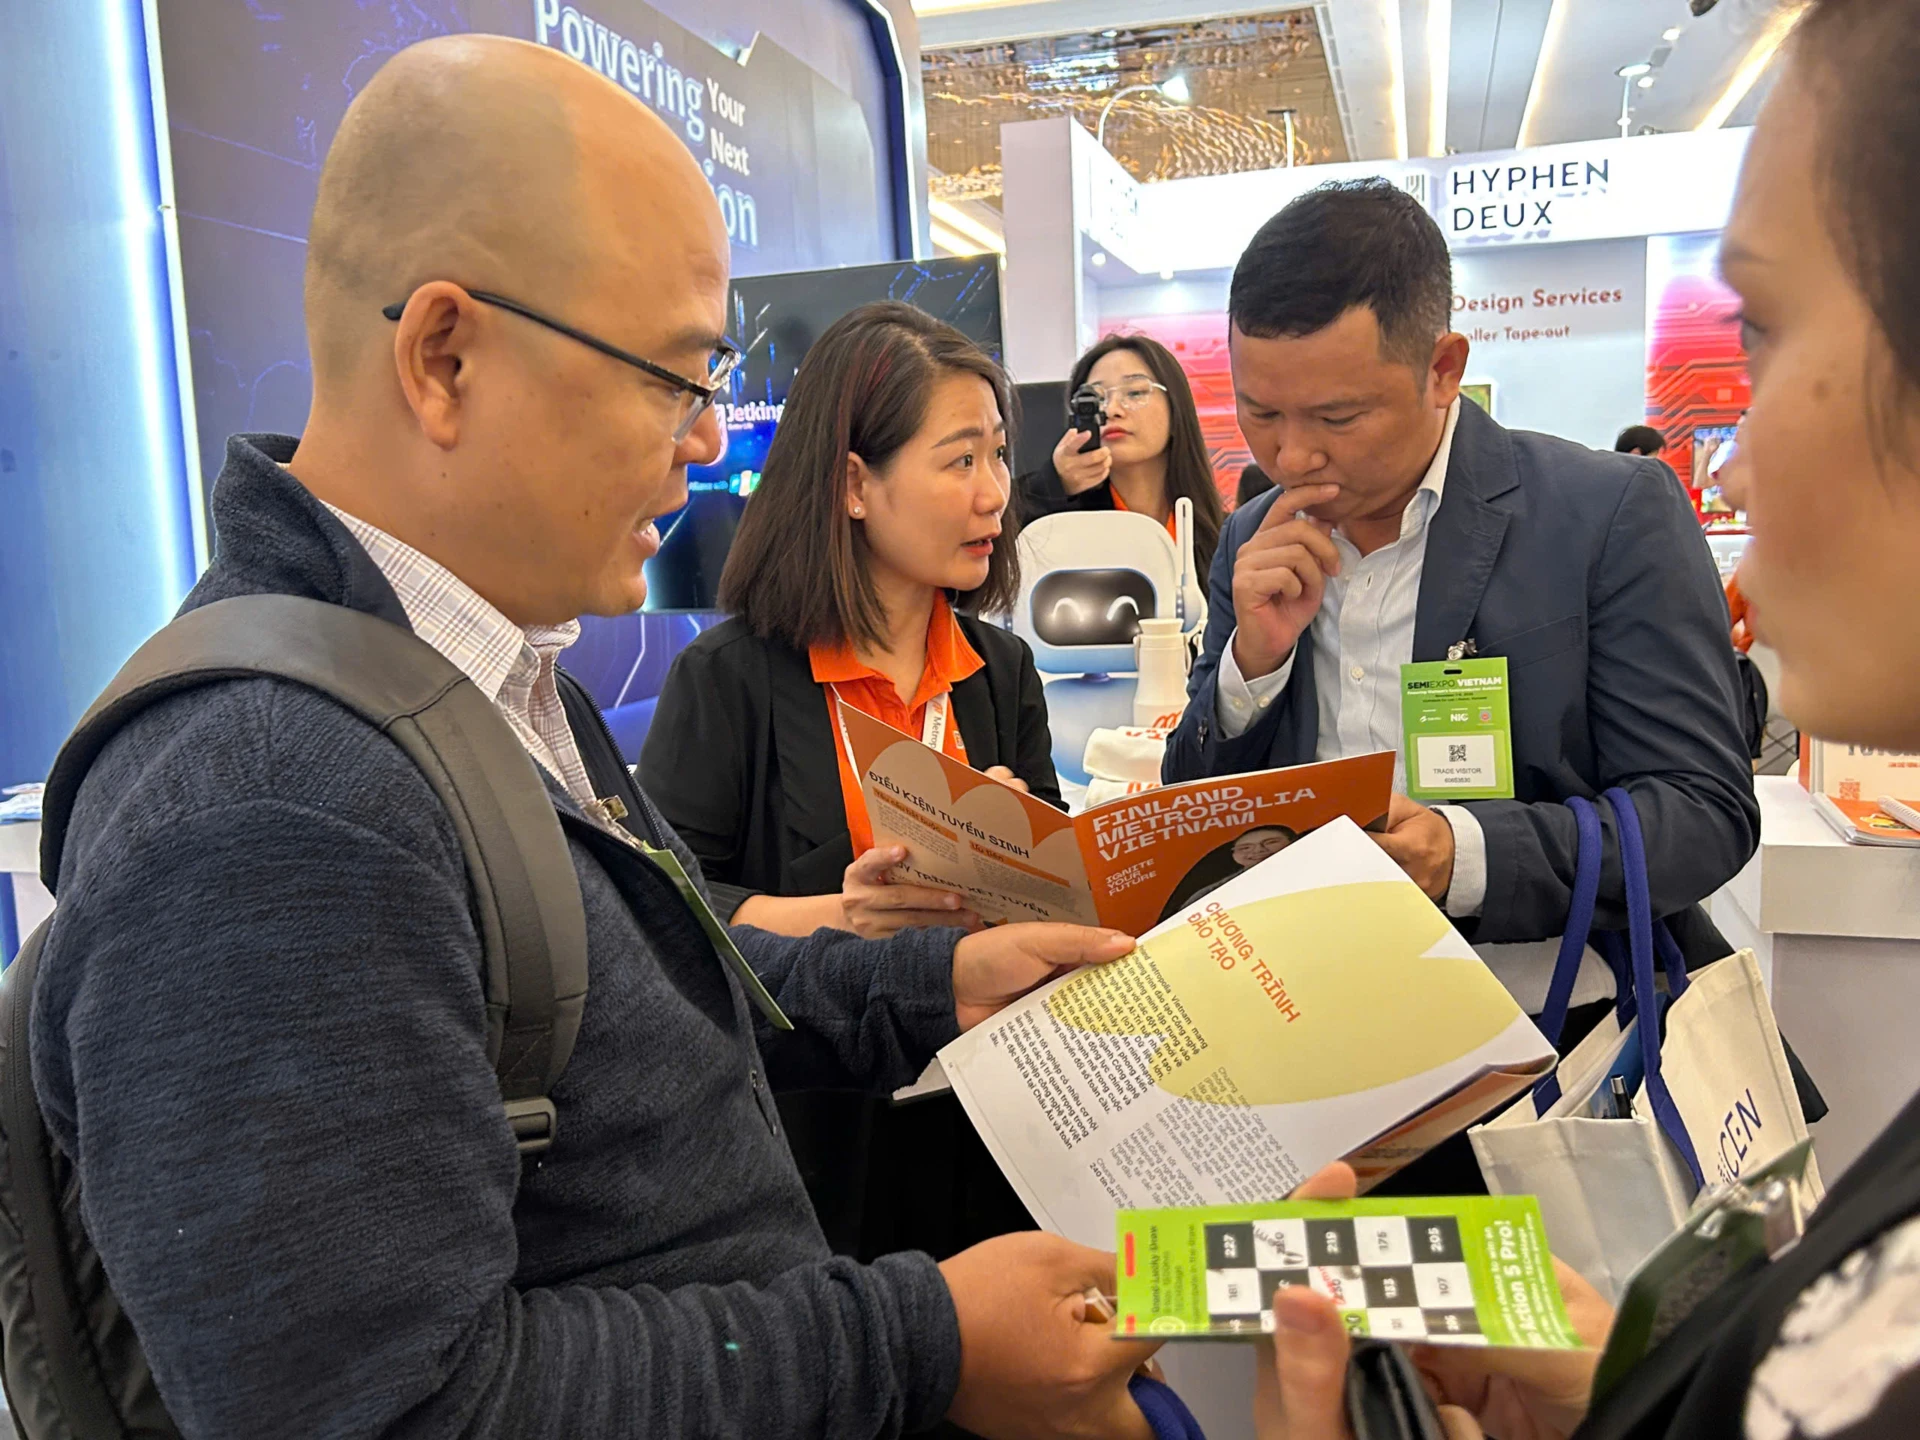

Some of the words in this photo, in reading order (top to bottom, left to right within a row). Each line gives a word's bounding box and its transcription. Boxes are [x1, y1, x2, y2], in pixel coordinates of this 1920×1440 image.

[534, 0, 705, 142] Powering
[706, 77, 747, 127] Your
[710, 130, 750, 176] Next
[1453, 159, 1609, 195] HYPHEN
[1453, 200, 1552, 232] DEUX
[1452, 293, 1523, 313] Design
[1533, 287, 1623, 308] Services
[1467, 328, 1498, 342] oller
[1504, 325, 1570, 343] Tape-out
[1457, 677, 1502, 687] VIETNAM
[1450, 713, 1469, 722] NIC
[902, 792, 937, 816] KIỆN
[938, 810, 985, 840] TUYỂN
[989, 836, 1030, 858] SINH
[1092, 786, 1244, 832] FINLAND
[1095, 787, 1317, 848] METROPOLIA
[1099, 811, 1255, 862] VIETNAM
[1105, 858, 1156, 885] IGNITE
[1107, 870, 1142, 890] YOUR
[1108, 870, 1157, 896] FUTURE
[1187, 911, 1214, 939] ĐÀO
[1207, 936, 1236, 971] TẠO
[1205, 901, 1254, 961] CHƯƠNG
[1250, 958, 1301, 1023] TRÌNH
[1146, 960, 1172, 994] Metropolia
[1170, 995, 1192, 1025] Vietnam
[1189, 1027, 1207, 1050] mang
[1223, 1234, 1238, 1259] 227
[1326, 1232, 1339, 1255] 219
[1427, 1227, 1444, 1253] 205
[1493, 1219, 1518, 1260] Pro!
[1437, 1277, 1449, 1296] 107
[1502, 1264, 1522, 1278] 5
[1508, 1280, 1538, 1331] Action
